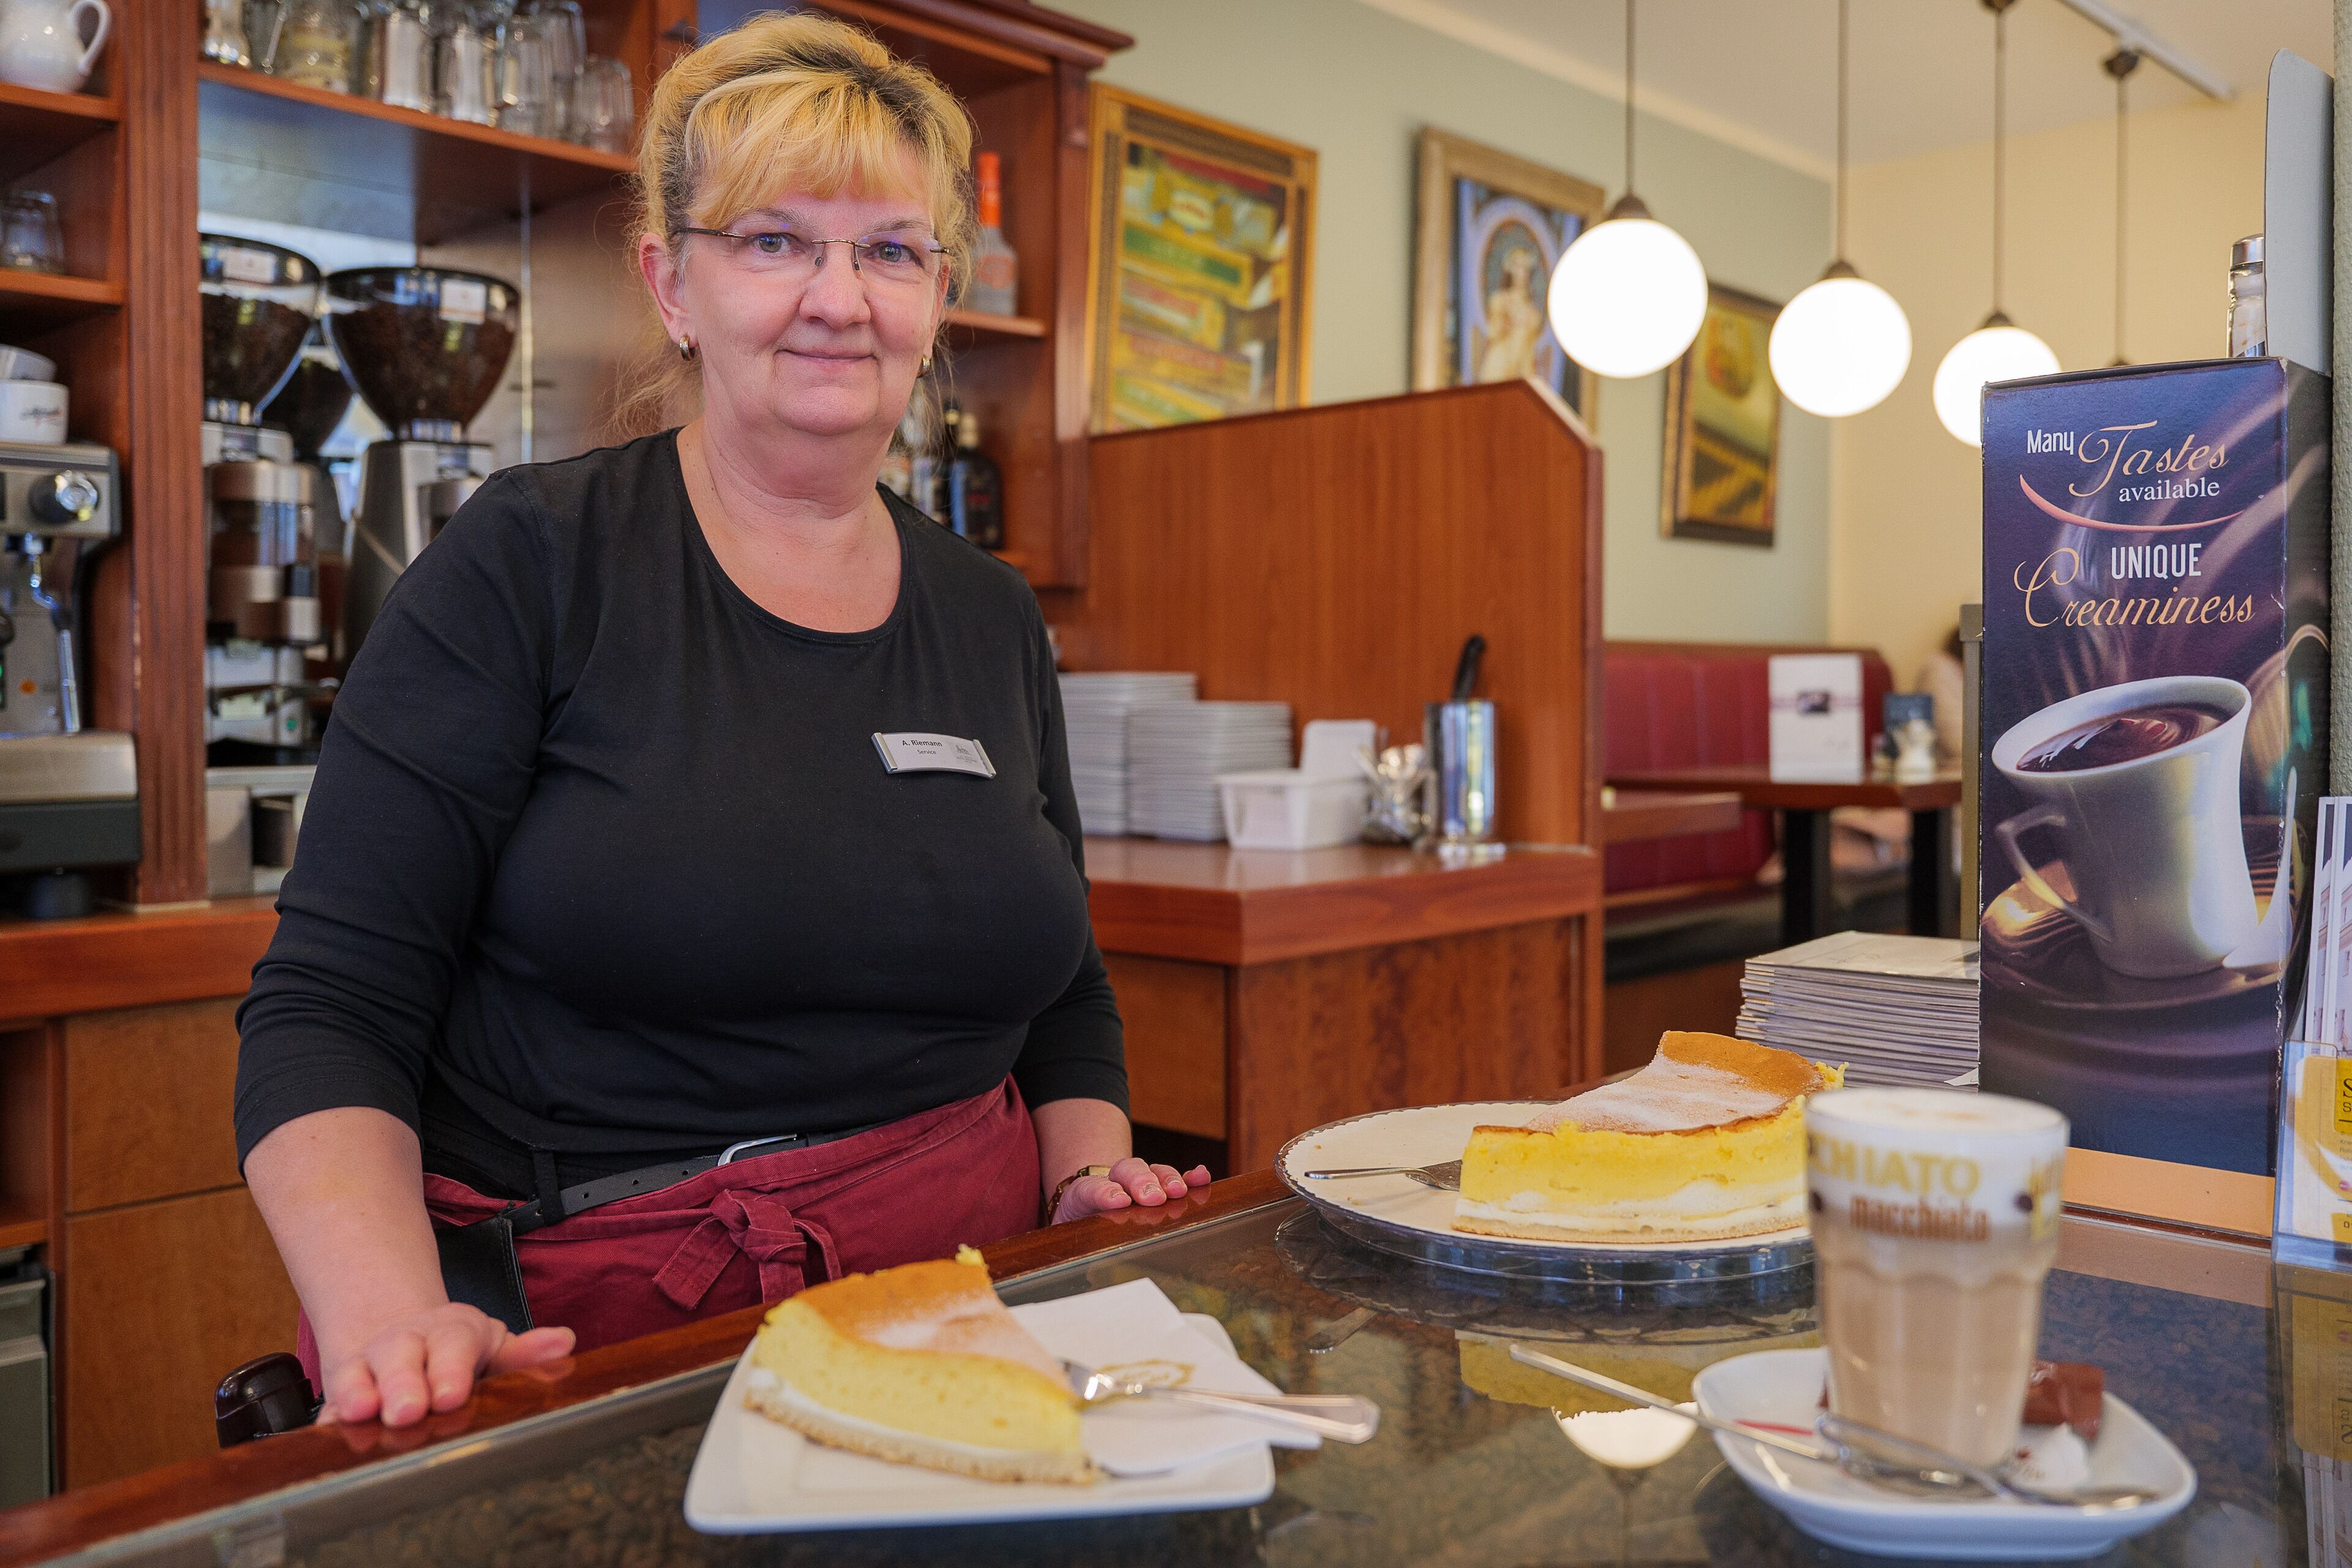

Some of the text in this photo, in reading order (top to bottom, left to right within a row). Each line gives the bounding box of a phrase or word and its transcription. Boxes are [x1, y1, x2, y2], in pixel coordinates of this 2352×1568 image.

[2027, 420, 2230, 497] Many Tastes
[2119, 477, 2220, 502] available
[2013, 548, 2256, 628] Creaminess
[2111, 543, 2202, 579] UNIQUE
